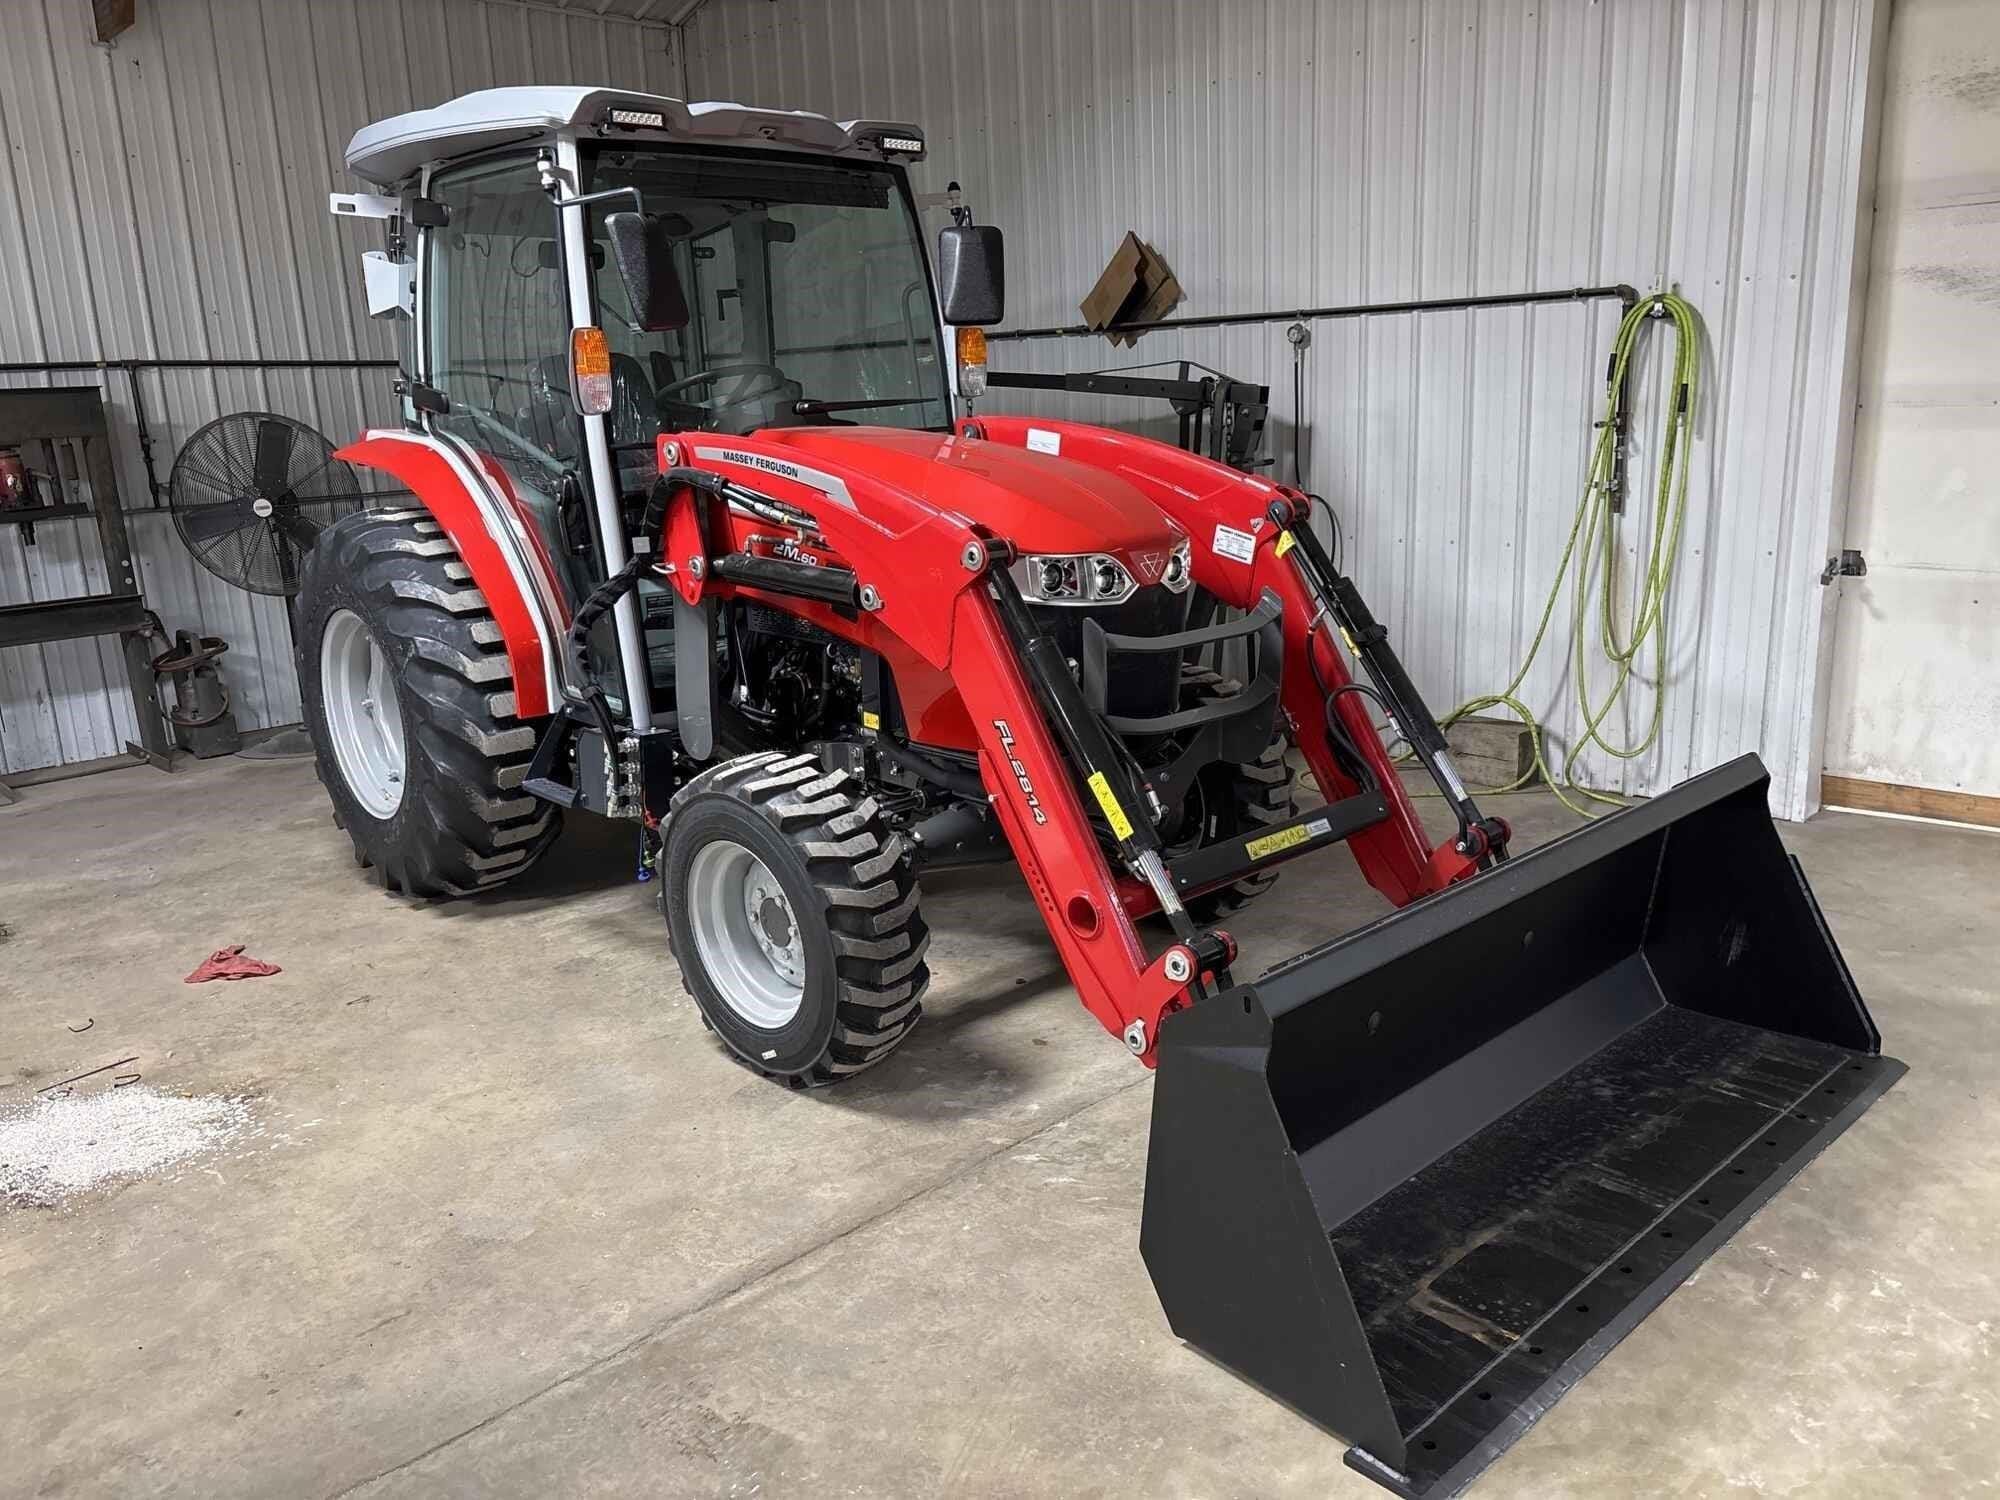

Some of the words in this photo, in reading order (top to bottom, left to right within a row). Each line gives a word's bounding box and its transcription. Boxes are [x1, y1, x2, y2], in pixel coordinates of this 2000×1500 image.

[722, 451, 755, 465] MASSEY
[756, 457, 799, 478] FERGUSON
[992, 719, 1047, 825] FL.2814
